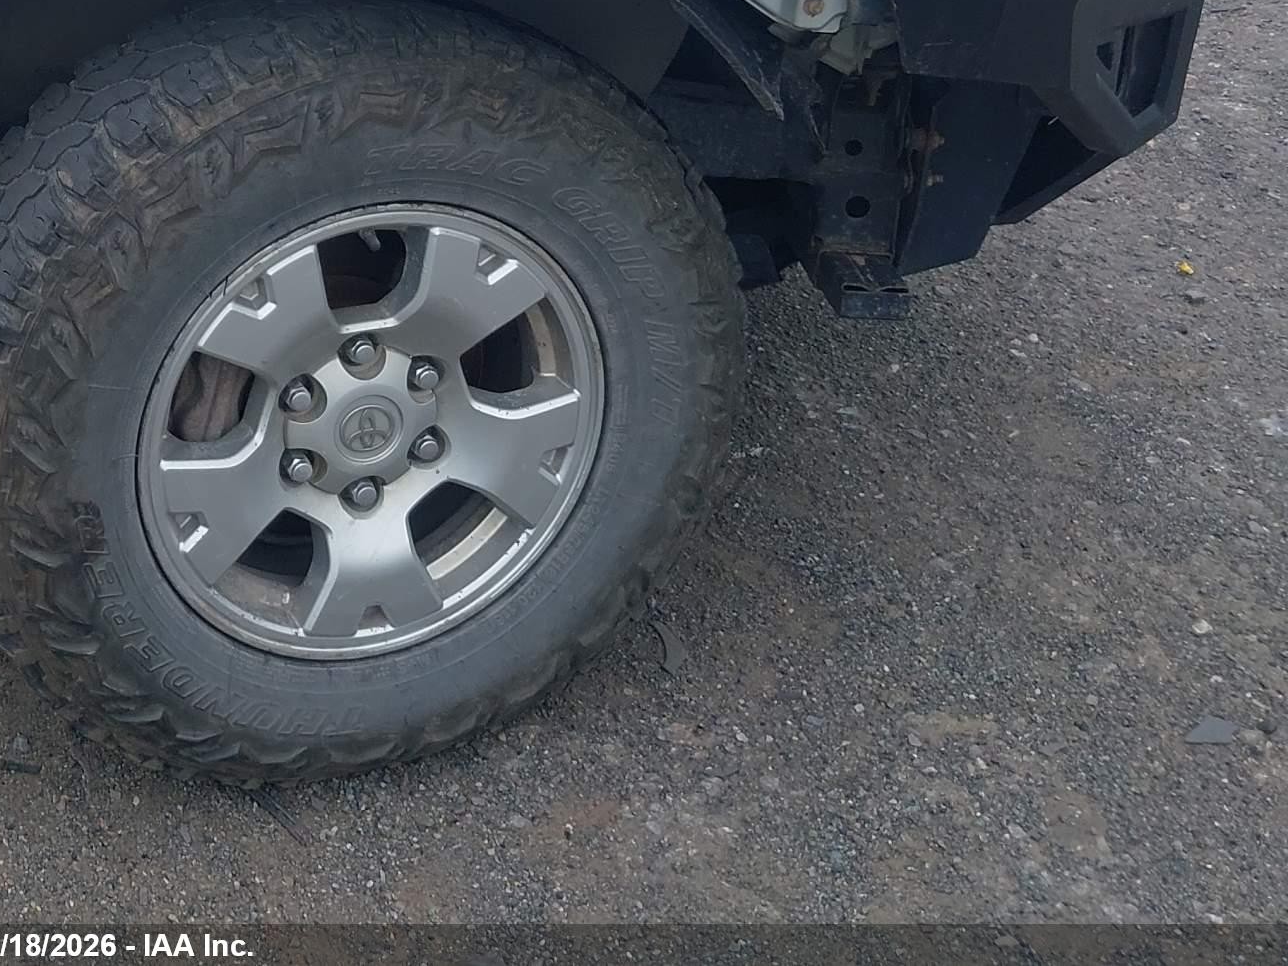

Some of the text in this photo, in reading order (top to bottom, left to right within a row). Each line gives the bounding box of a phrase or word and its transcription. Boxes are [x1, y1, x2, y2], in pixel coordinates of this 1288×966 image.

[363, 142, 550, 186] TRAC
[551, 186, 665, 298] GRIP
[72, 499, 365, 736] THUNDERER
